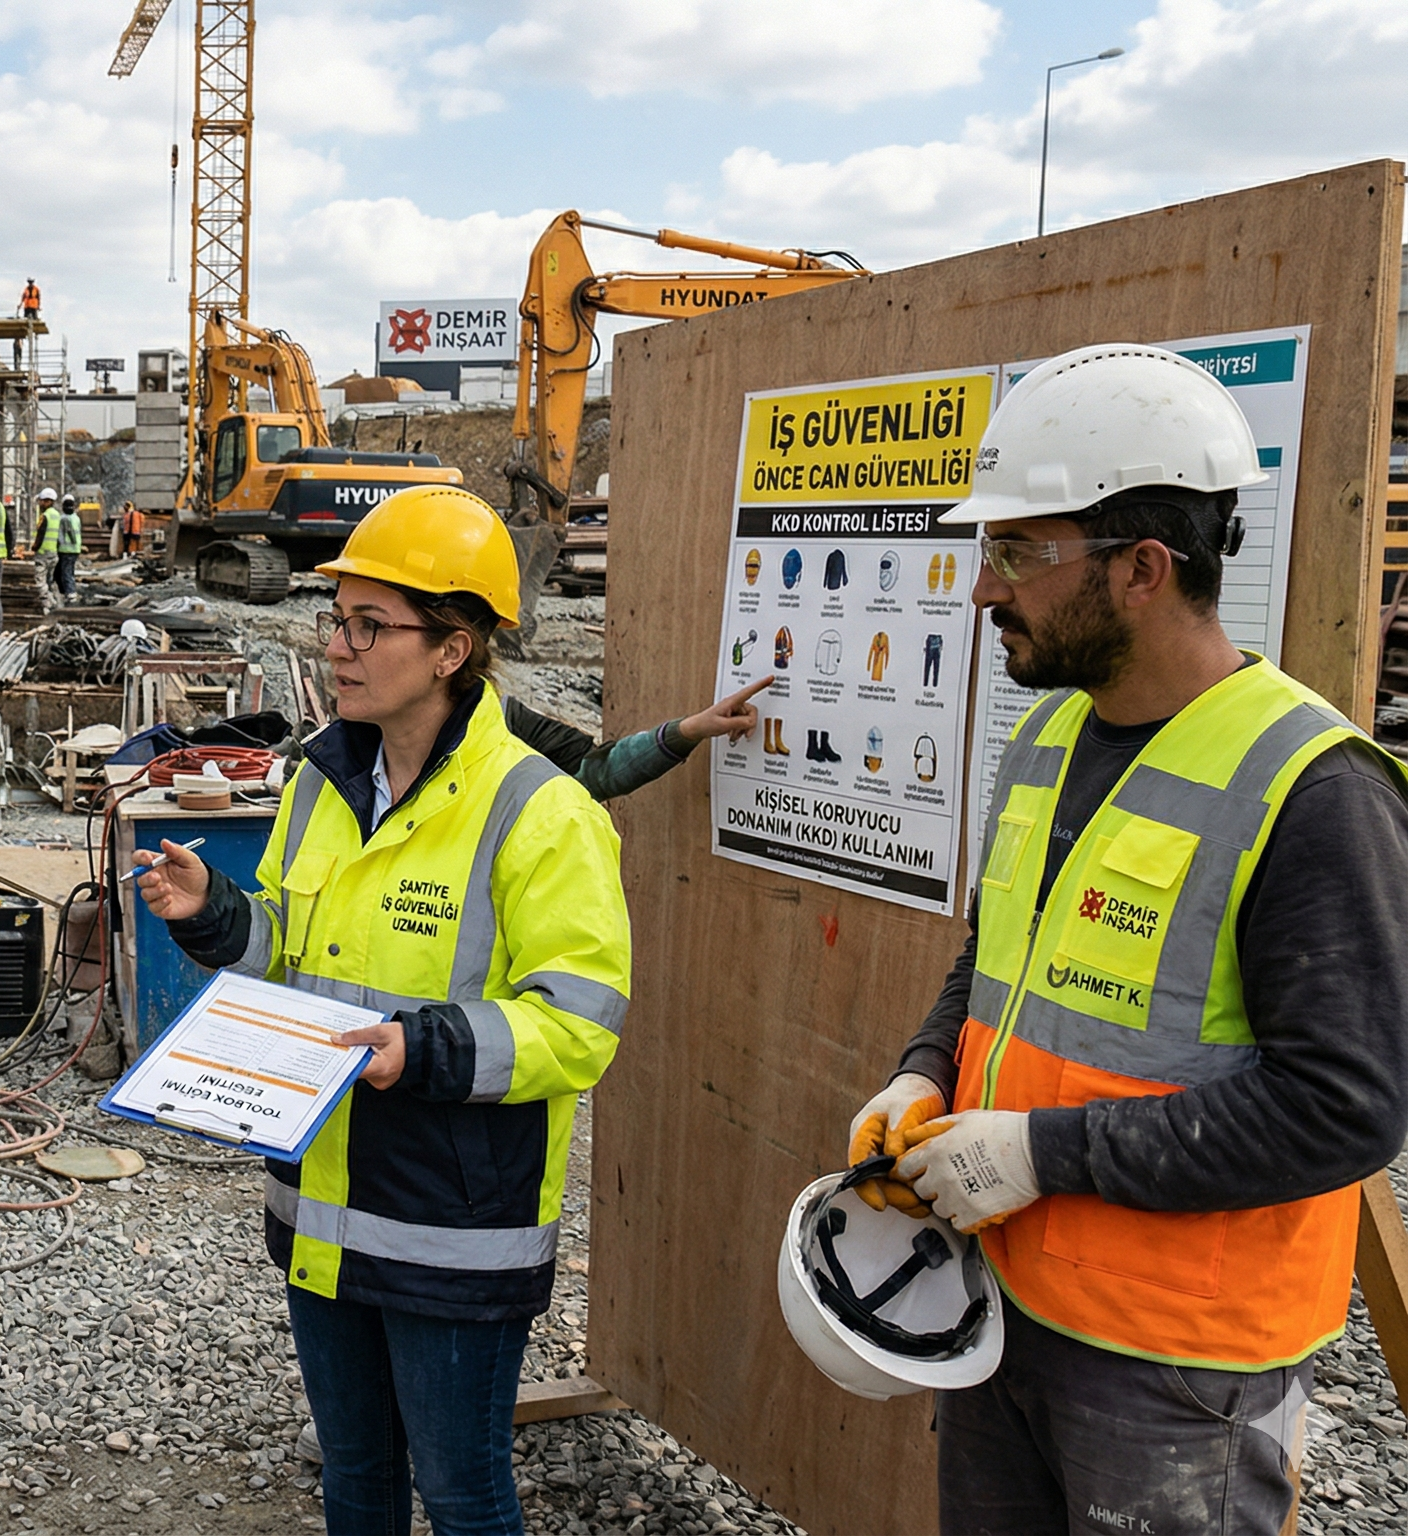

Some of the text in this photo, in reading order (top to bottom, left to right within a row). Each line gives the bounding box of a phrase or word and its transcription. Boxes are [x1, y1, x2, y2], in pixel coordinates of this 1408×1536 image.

[436, 310, 507, 329] DEMİR
[435, 331, 507, 352] İNŞAAT
[770, 386, 966, 457] İŞ GÜVENLİĞİ
[753, 460, 805, 491] ÖNCE
[809, 463, 850, 490] CAN
[854, 448, 971, 488] GÜVENLİĞİ
[335, 487, 402, 505] HYUN
[771, 508, 931, 533] KKD KONTROL LİSTESİ
[755, 786, 901, 835] KİŞİSEL KORUYUCU
[728, 807, 792, 838] DONANIM
[795, 822, 838, 850] (KKD)
[842, 832, 934, 870] KULLANIMI
[1107, 897, 1159, 925] DEMİR
[392, 917, 438, 937] UZMANI
[1068, 971, 1144, 1008] AHMET K.
[212, 1093, 282, 1119] TOOLBOX
[1087, 1503, 1155, 1535] AHMET K.
